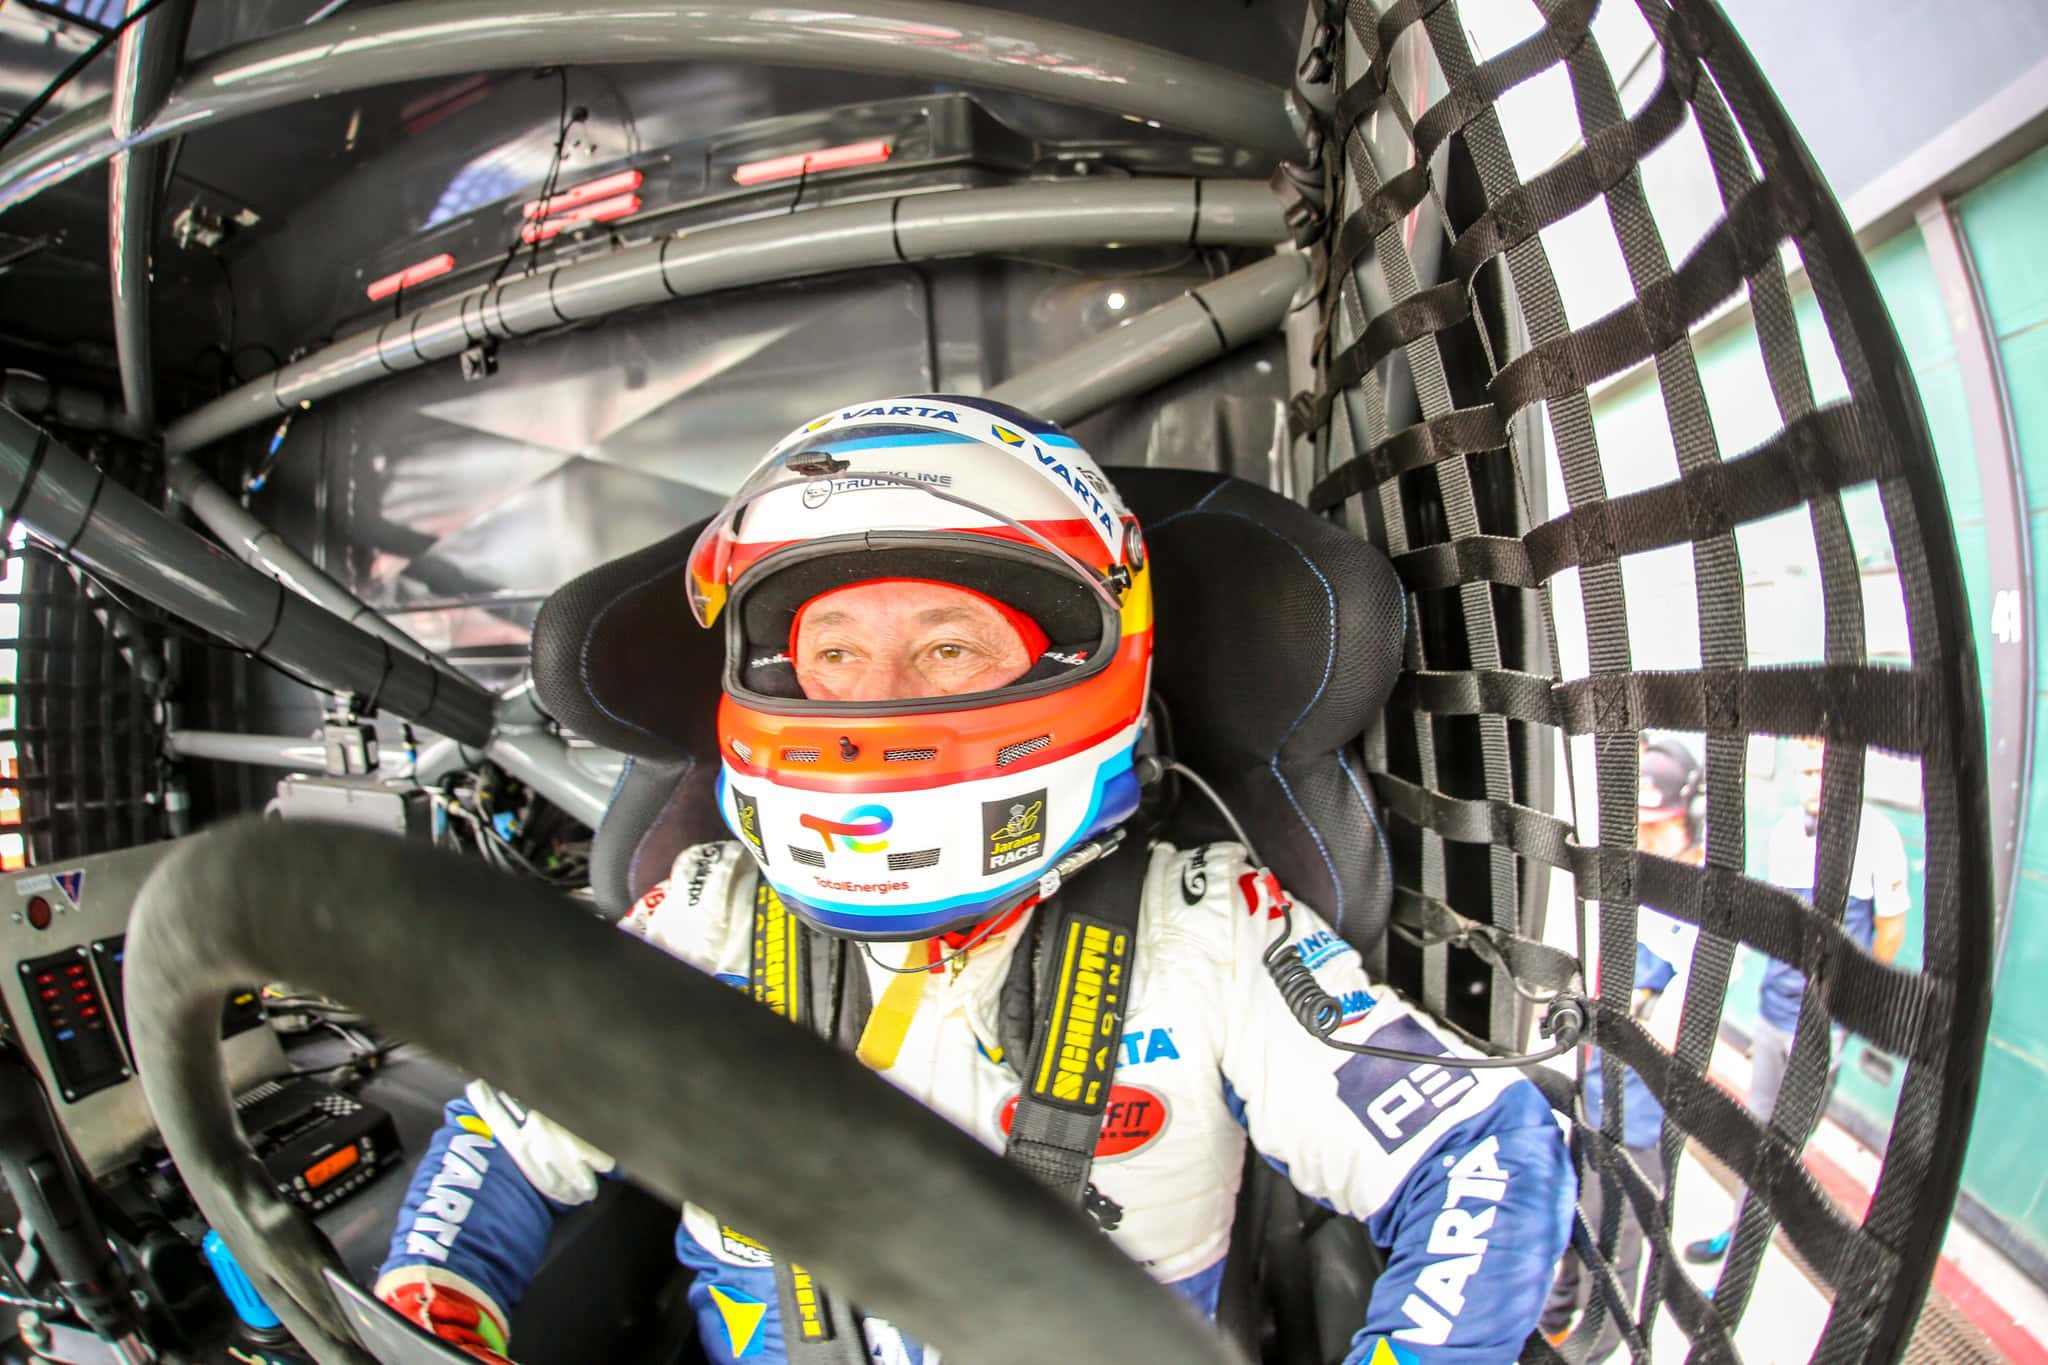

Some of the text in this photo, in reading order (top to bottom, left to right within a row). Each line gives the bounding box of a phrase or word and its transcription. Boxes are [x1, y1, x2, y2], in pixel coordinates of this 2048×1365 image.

[842, 406, 959, 423] VARTA
[1033, 444, 1113, 539] VARTA
[990, 842, 1040, 869] RACE
[991, 832, 1041, 855] Jarama
[813, 875, 910, 894] TotalEnergies
[1052, 925, 1111, 1101] SCHROTH
[1085, 935, 1126, 1104] RACING
[1115, 1028, 1180, 1068] TA
[1103, 1102, 1151, 1128] FIT
[404, 1133, 497, 1262] VARTA
[1391, 1135, 1510, 1346] VARTA
